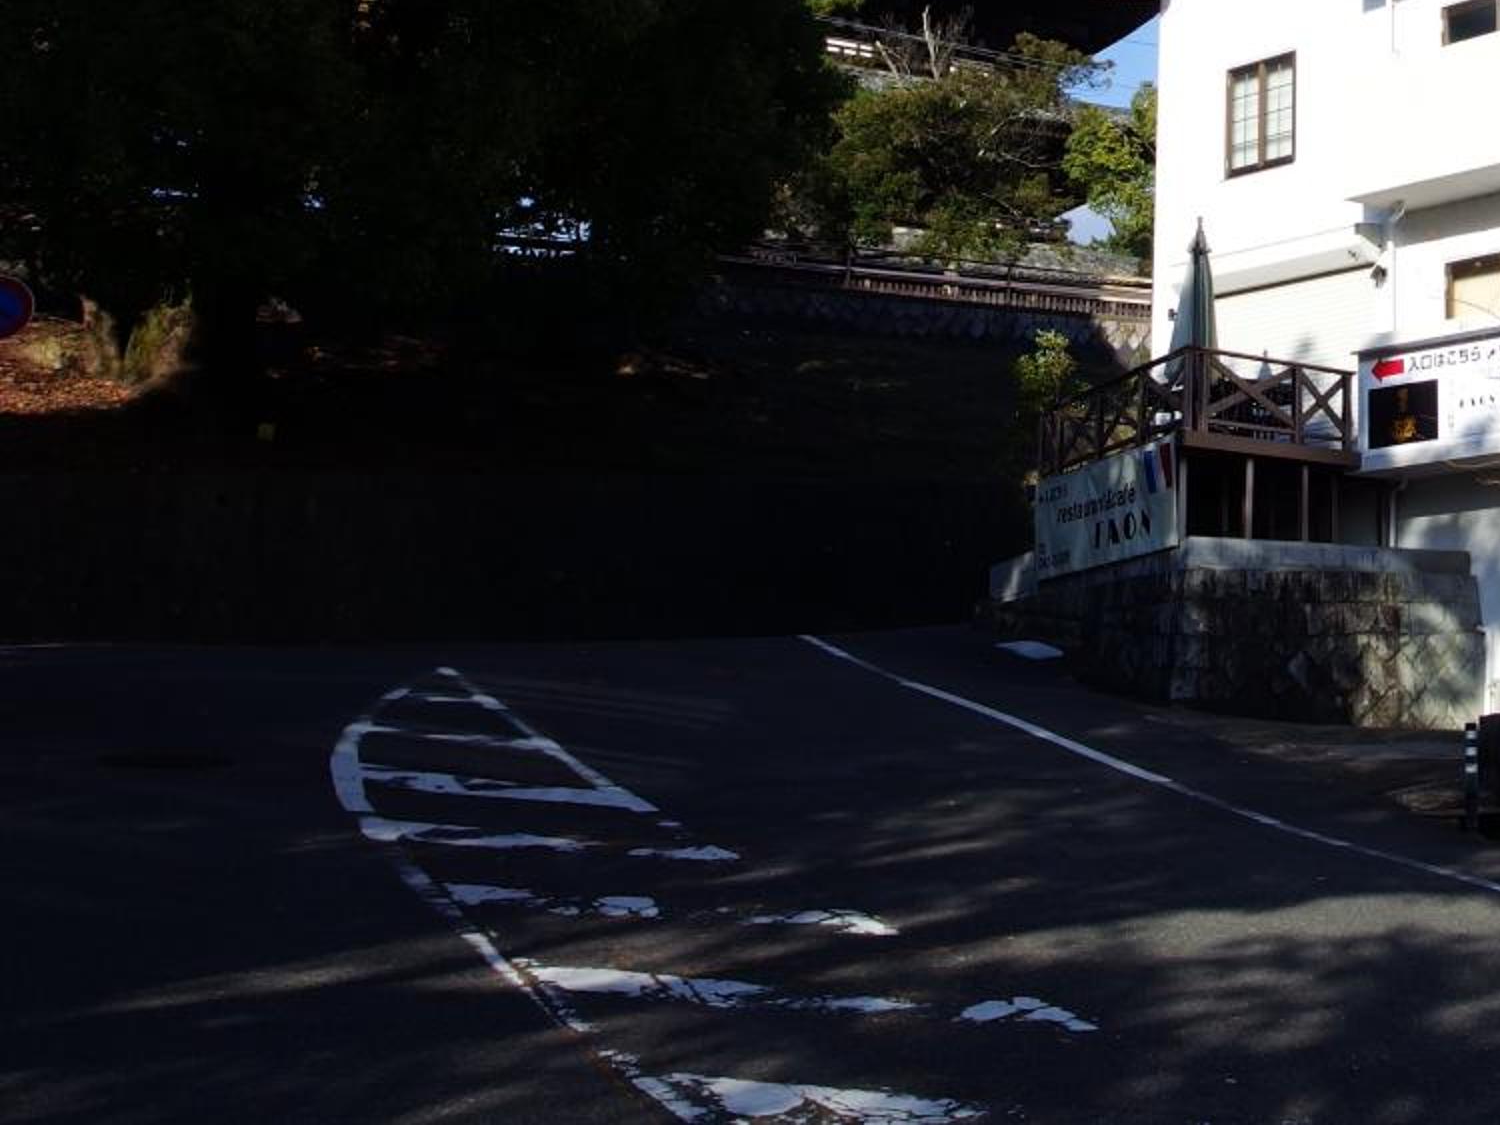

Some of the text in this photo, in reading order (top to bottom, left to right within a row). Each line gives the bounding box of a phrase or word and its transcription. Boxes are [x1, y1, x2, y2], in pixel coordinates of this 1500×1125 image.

[1407, 345, 1482, 373] 入口はこちら
